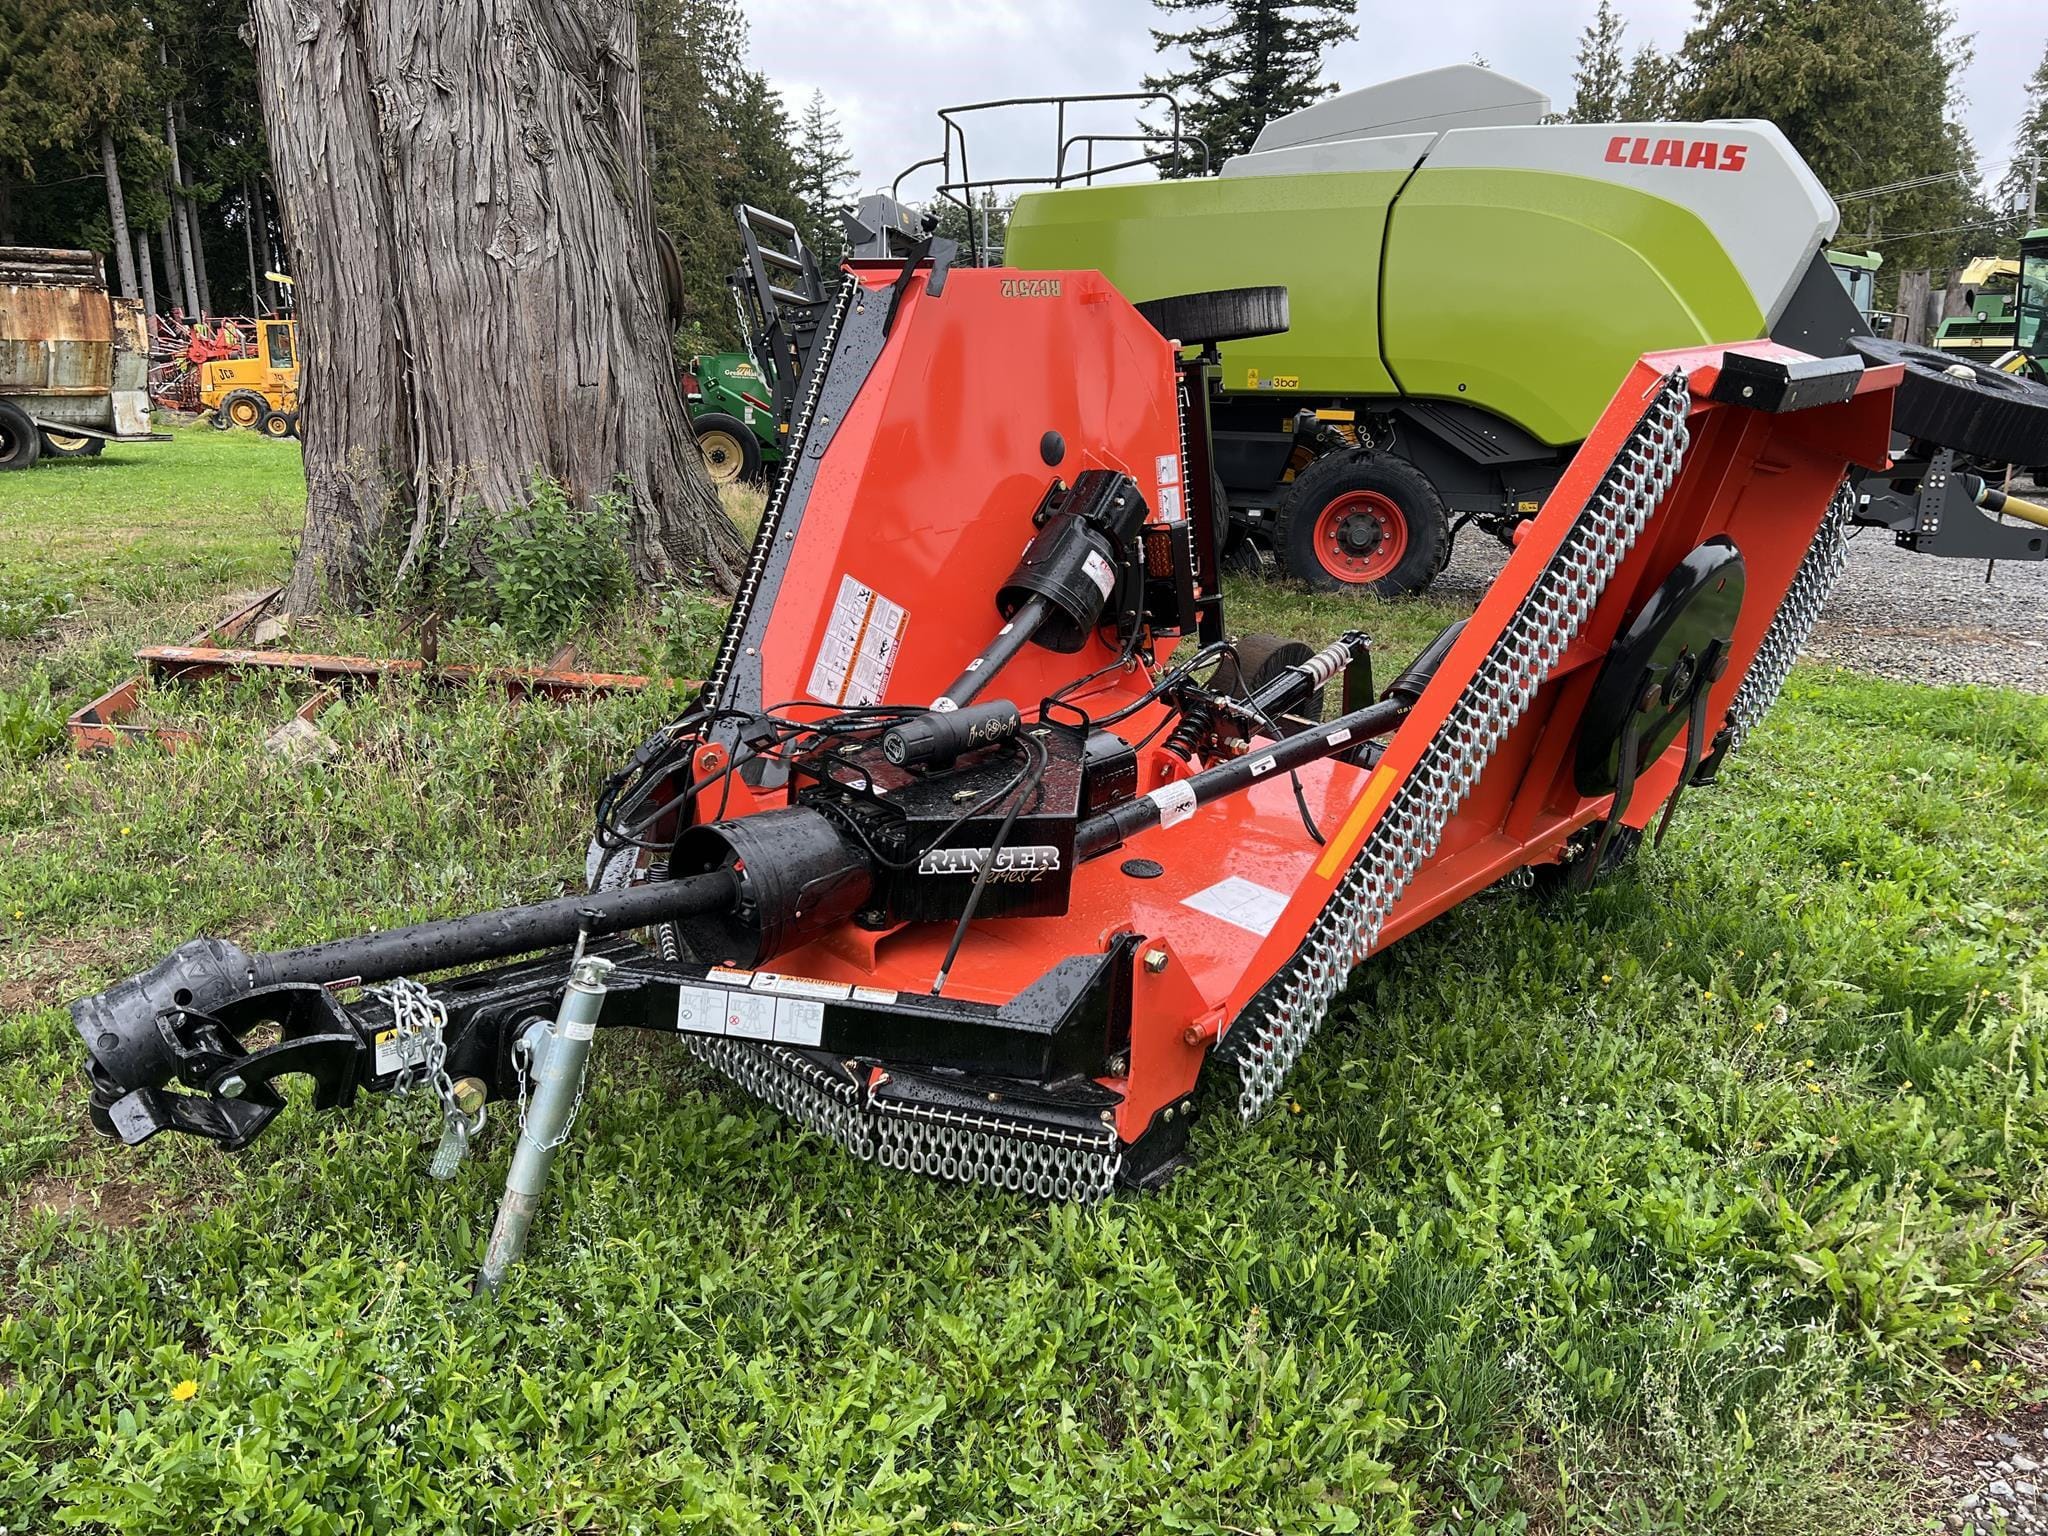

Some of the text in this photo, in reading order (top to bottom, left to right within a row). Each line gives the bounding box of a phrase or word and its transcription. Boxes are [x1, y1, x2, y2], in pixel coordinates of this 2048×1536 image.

[1604, 136, 1748, 172] CLAAS
[1000, 279, 1062, 298] RC2512
[219, 369, 235, 381] JCB
[919, 845, 1060, 875] RANGER
[1030, 863, 1049, 883] 2
[793, 976, 843, 987] WARNING
